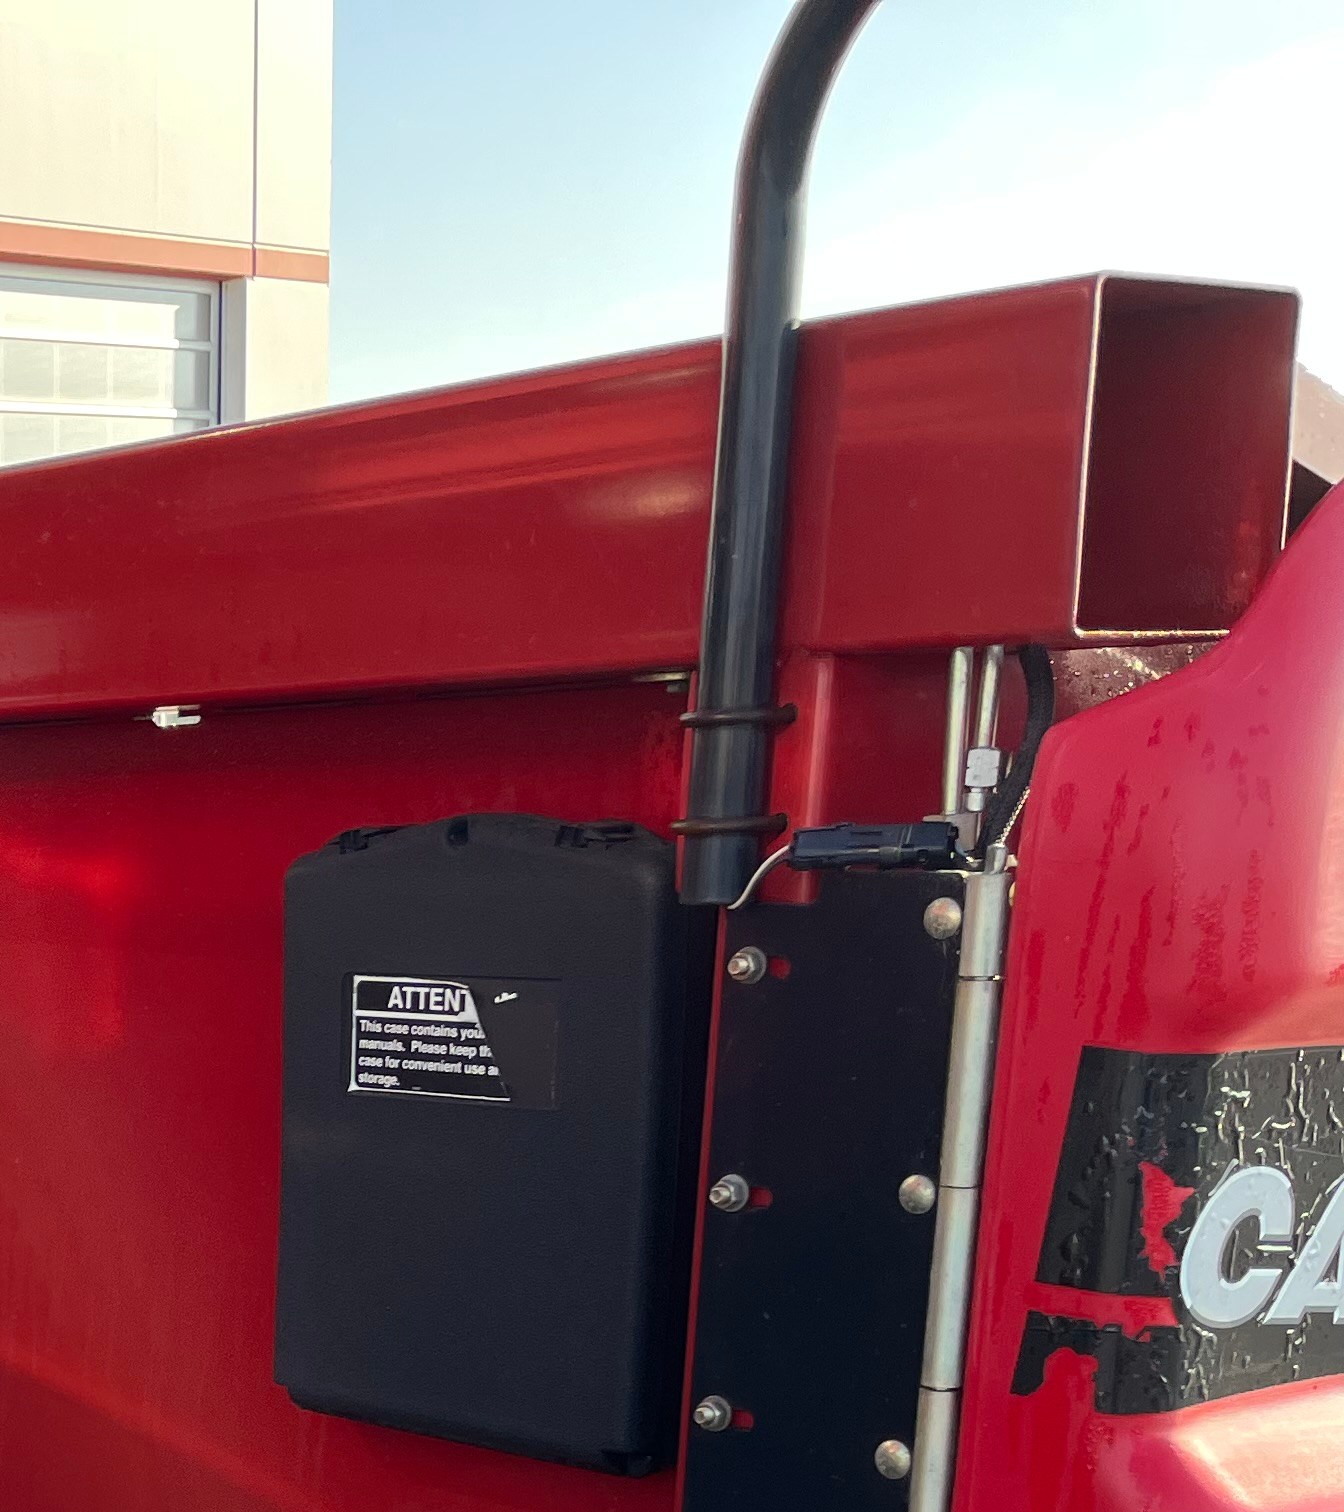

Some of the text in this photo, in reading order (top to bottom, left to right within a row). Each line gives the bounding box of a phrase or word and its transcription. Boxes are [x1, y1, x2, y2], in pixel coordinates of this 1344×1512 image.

[359, 1020, 382, 1033] This
[384, 1023, 409, 1035] case
[410, 1024, 458, 1038] contains
[358, 1039, 406, 1052] manuals.
[410, 1040, 448, 1055] Please
[449, 1043, 477, 1059] keep
[358, 1056, 383, 1067] case
[384, 1055, 401, 1069] for
[401, 1058, 463, 1074] convenient
[464, 1063, 486, 1075] use
[357, 1072, 400, 1087] storage.
